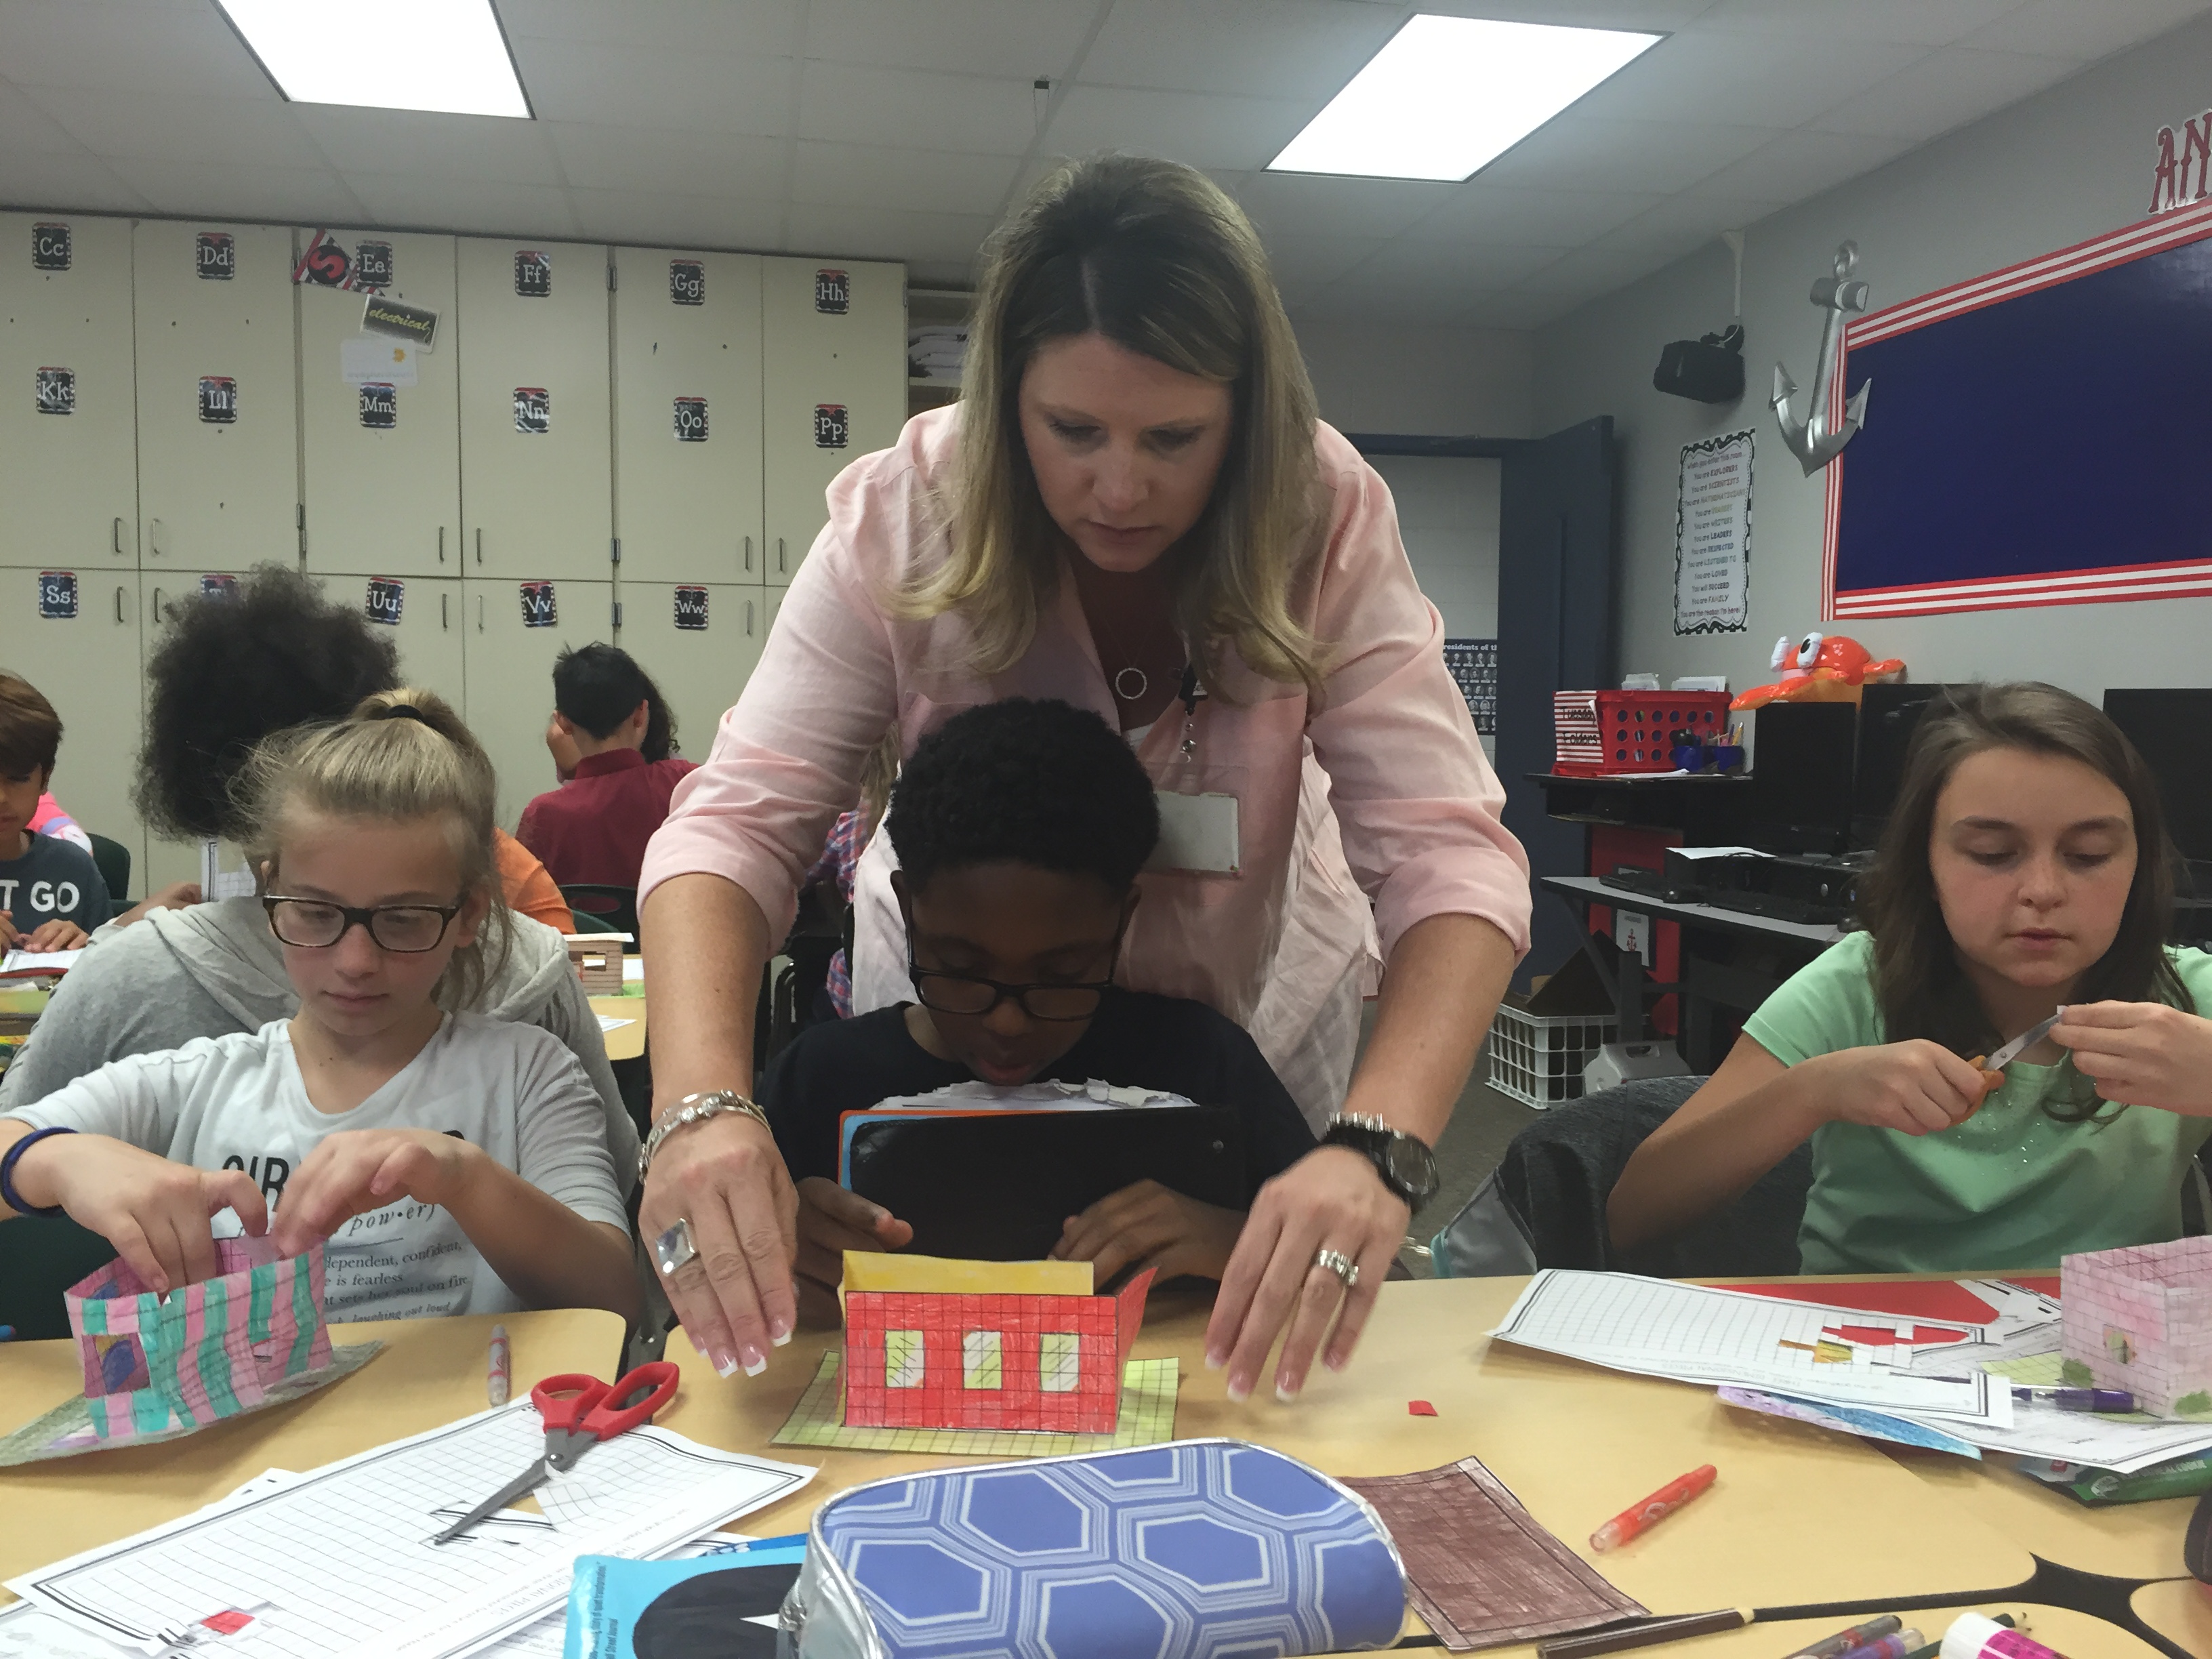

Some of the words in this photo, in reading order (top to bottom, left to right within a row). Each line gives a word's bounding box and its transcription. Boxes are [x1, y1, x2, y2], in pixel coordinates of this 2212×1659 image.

[39, 238, 64, 255] Cc
[203, 245, 228, 266] Dd
[363, 253, 386, 273] Ee
[523, 264, 541, 283] Ff
[674, 273, 700, 298] Gg
[820, 283, 844, 301] Hh
[369, 307, 430, 333] electrical
[41, 380, 70, 401] Kk
[363, 397, 392, 413] Mm
[519, 401, 544, 419] Nn
[680, 411, 703, 428] Oo
[820, 417, 842, 439] Pp
[45, 586, 71, 604] Ss
[372, 590, 398, 612] Uu
[525, 594, 552, 614] Vv
[678, 600, 706, 615] Ww
[30, 880, 80, 913] GO
[326, 1254, 399, 1272] dependent,
[336, 1275, 347, 1286] is
[352, 1272, 403, 1286] fearless
[426, 1282, 445, 1292] on
